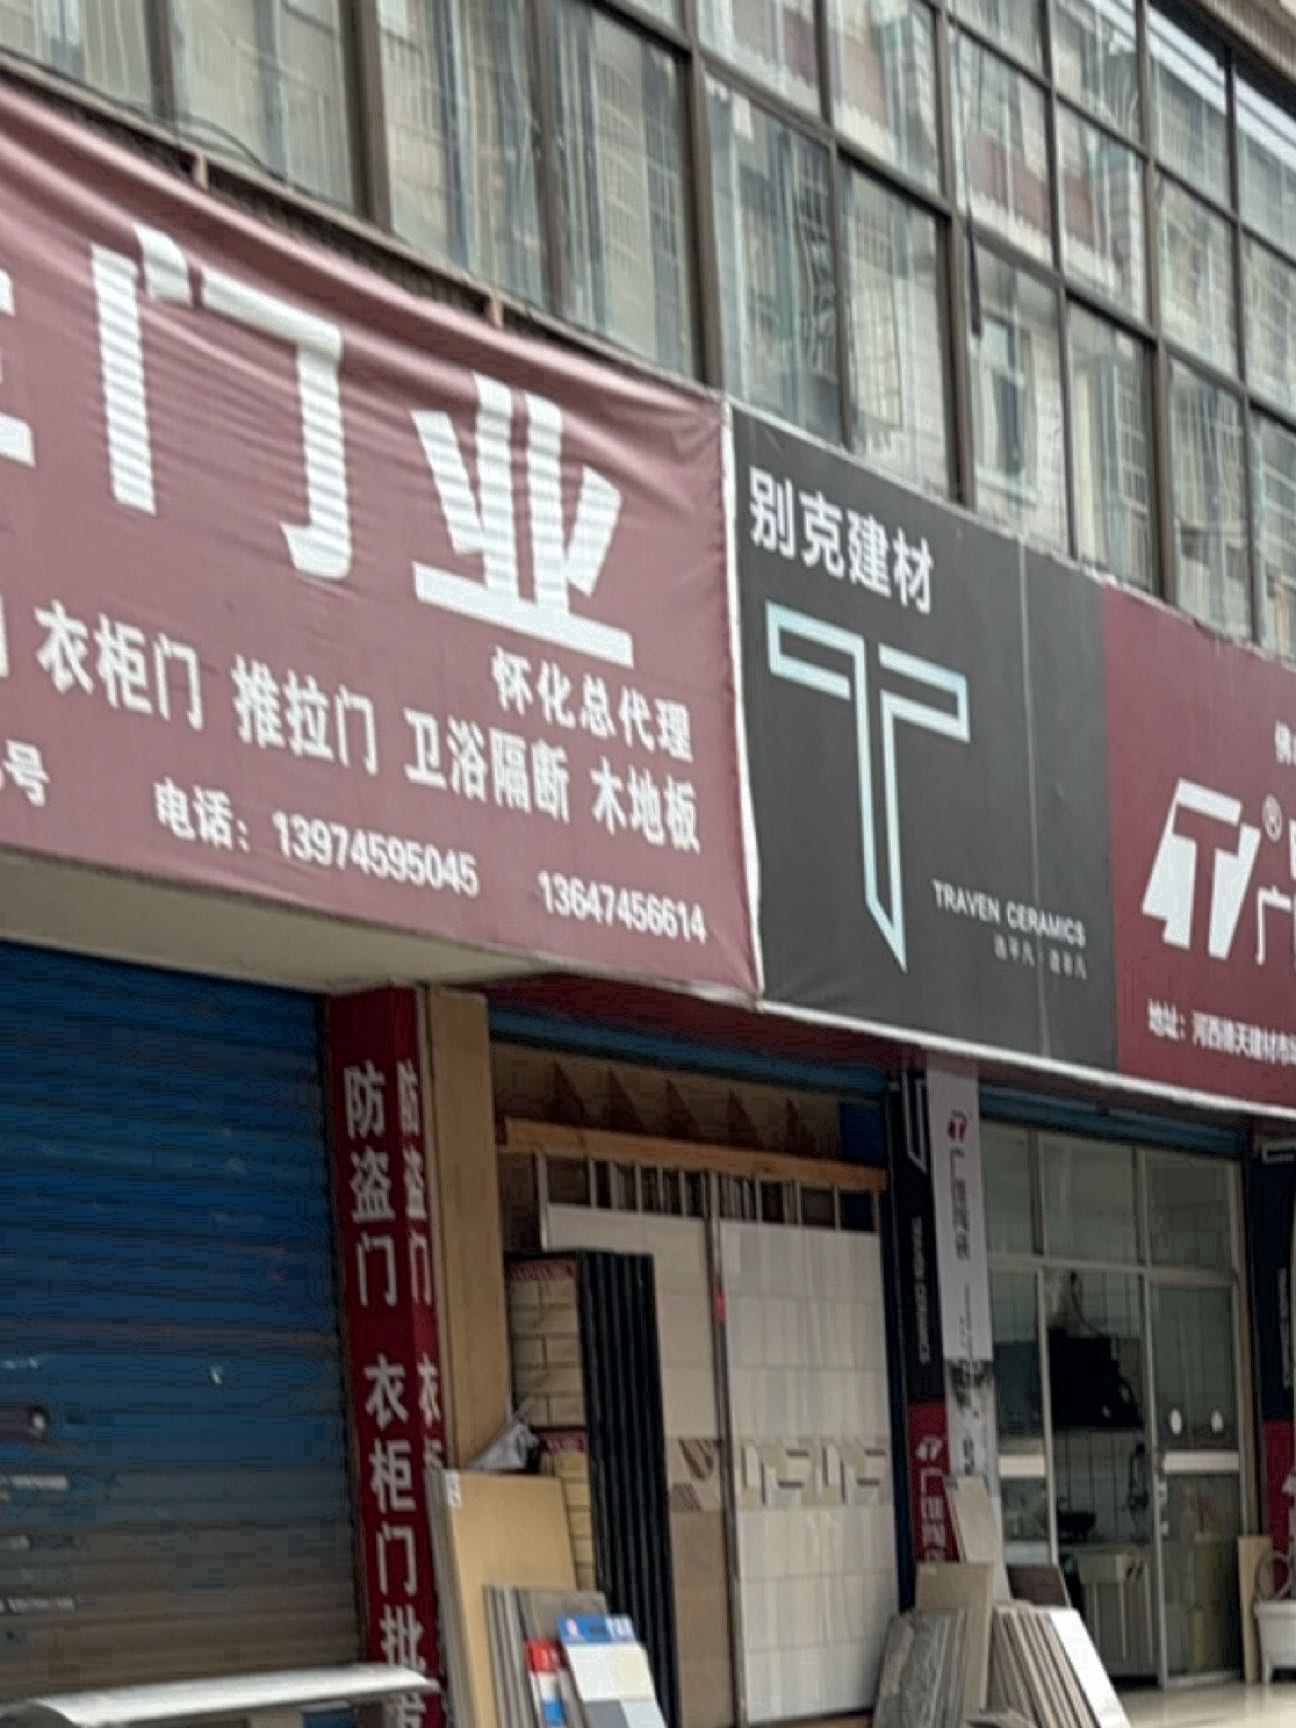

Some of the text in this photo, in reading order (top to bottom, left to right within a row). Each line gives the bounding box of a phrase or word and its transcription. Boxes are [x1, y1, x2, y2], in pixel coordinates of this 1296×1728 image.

[0, 222, 635, 668] 门业
[750, 465, 934, 615] 别克建材
[0, 738, 50, 807] 号
[34, 598, 701, 855] 衣柜门 推拉门 卫浴隔断 木地板
[491, 645, 694, 764] 怀化总代理
[272, 810, 481, 899] 13974595045
[537, 869, 708, 945] 13647456614
[930, 877, 1001, 924] TRAVEN
[343, 1058, 397, 1308] 防盗门
